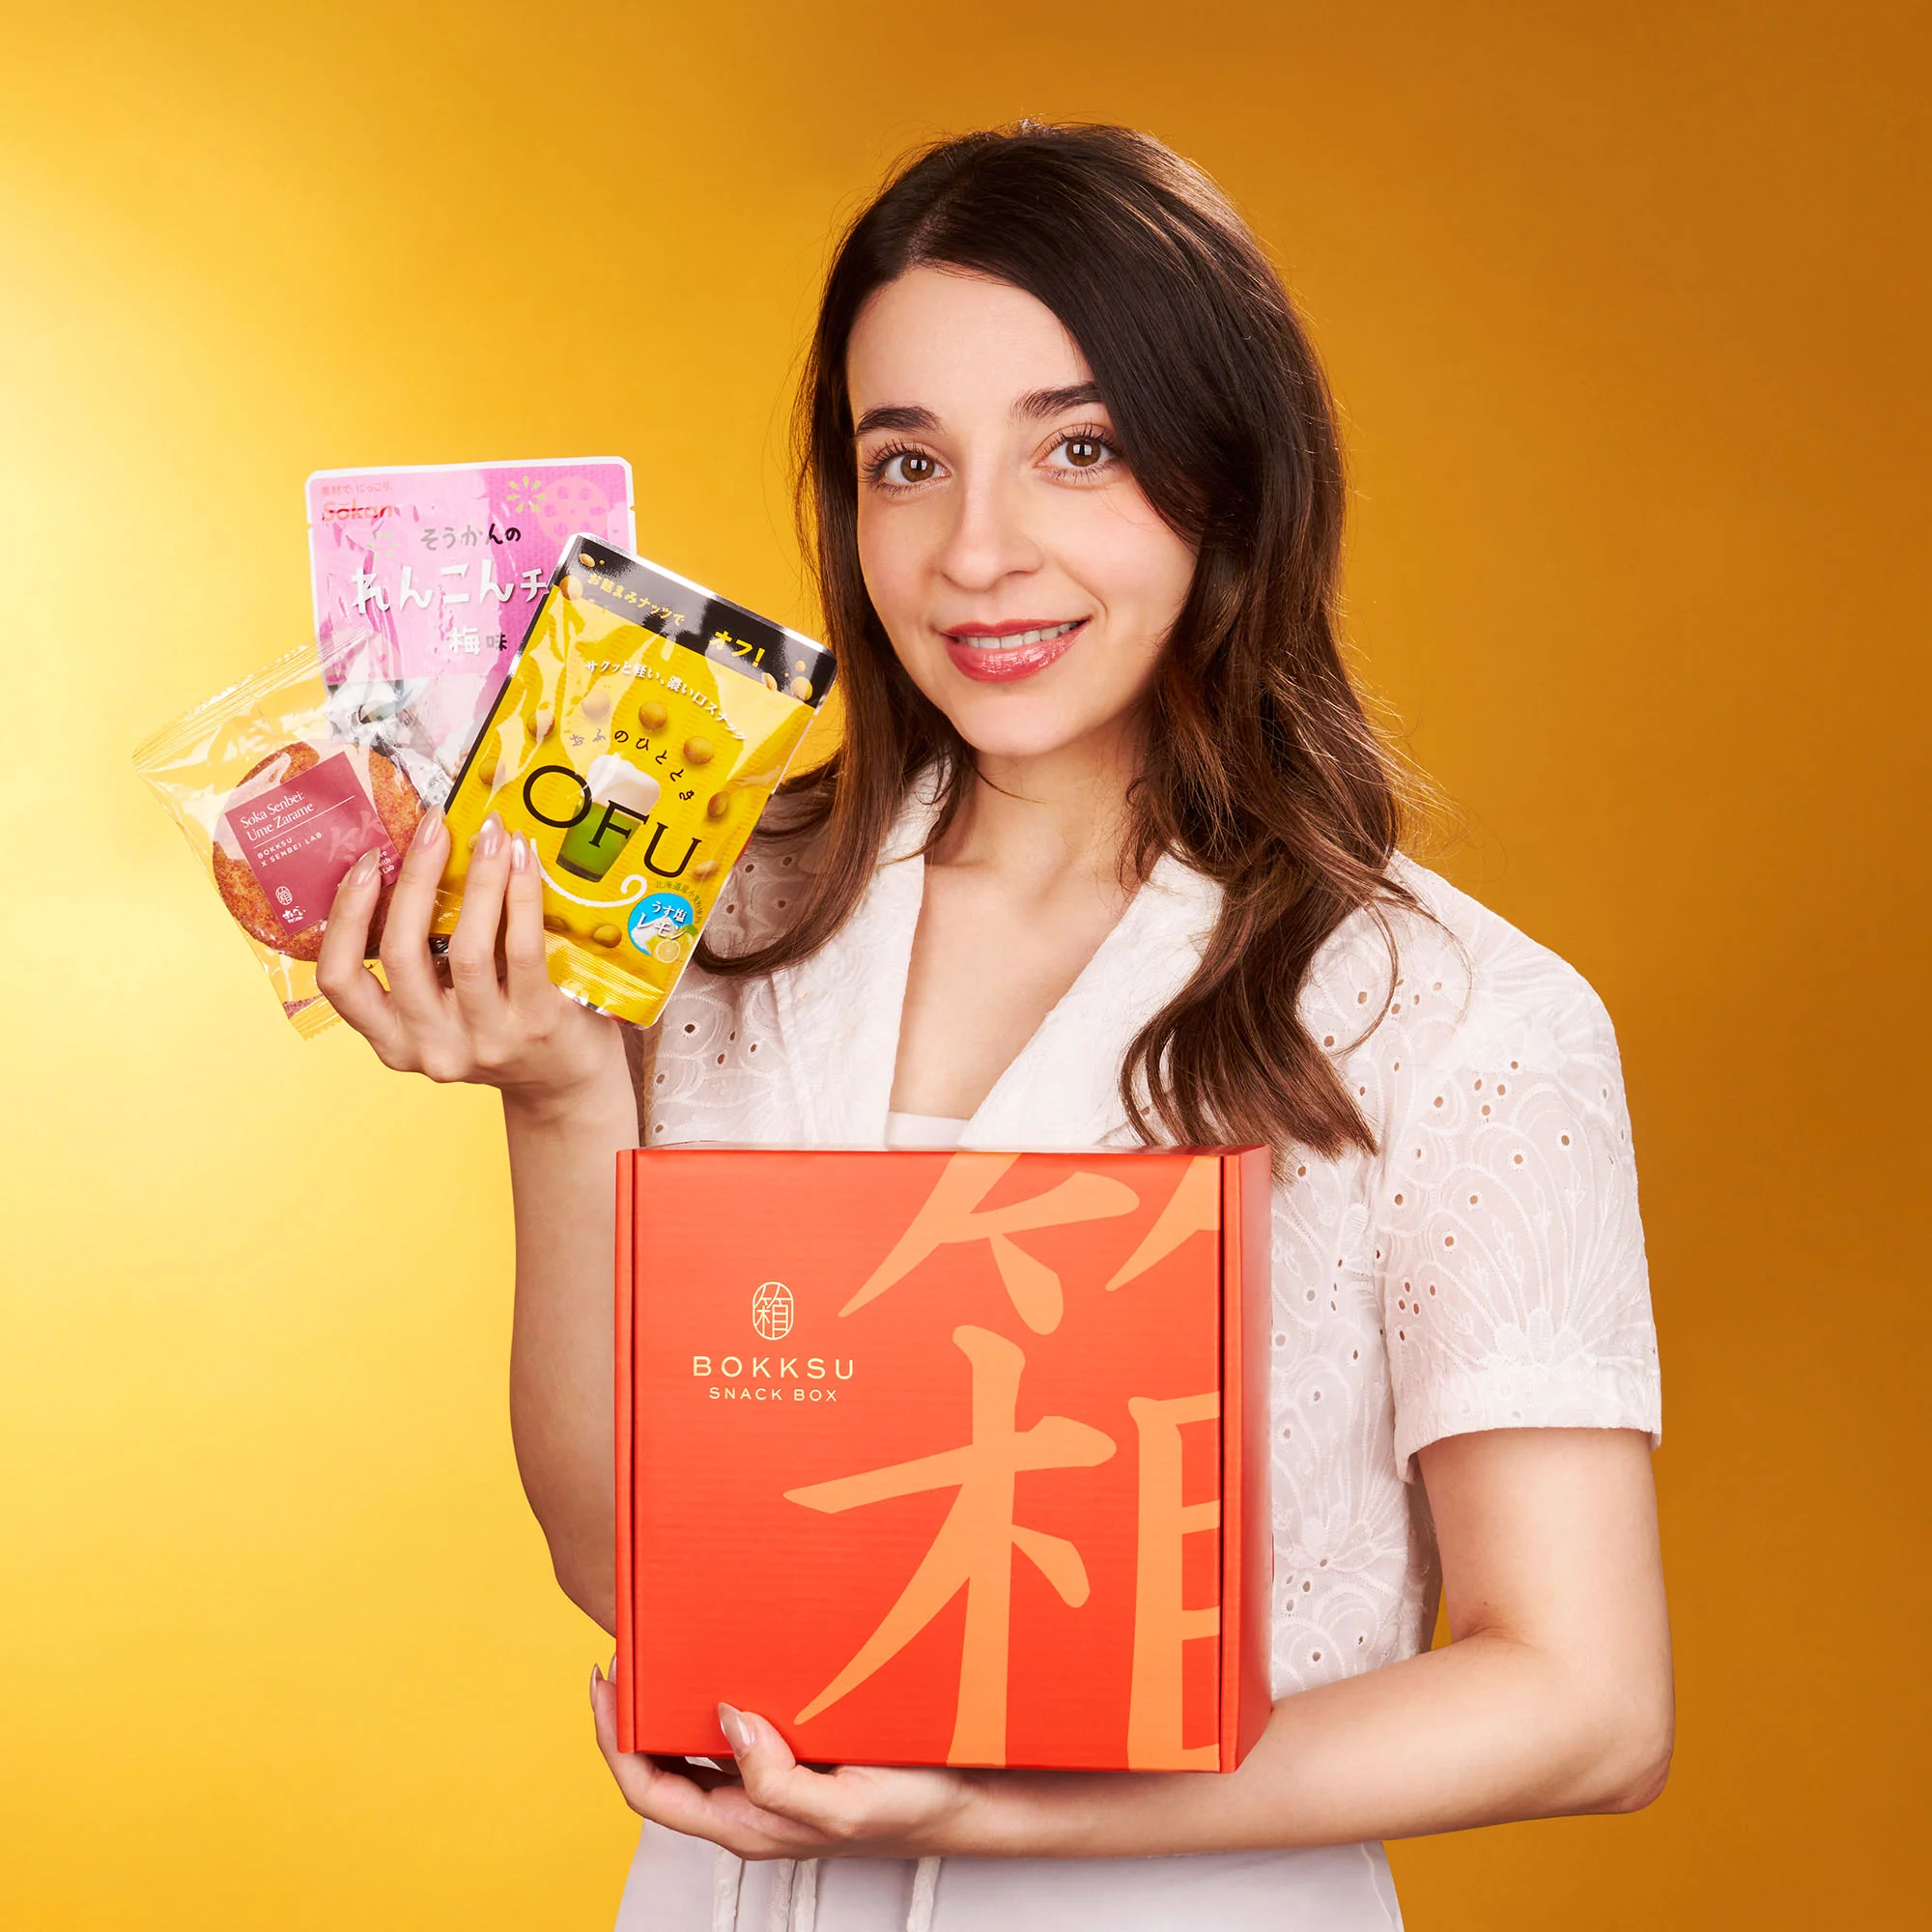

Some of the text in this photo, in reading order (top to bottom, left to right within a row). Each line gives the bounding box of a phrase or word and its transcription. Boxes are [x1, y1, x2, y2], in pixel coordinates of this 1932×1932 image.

[420, 523, 522, 551] そうかんの
[352, 558, 548, 614] れんこんチ
[240, 790, 305, 829] Soka Senbei:
[246, 803, 314, 841] Ume Zarame
[523, 764, 702, 878] OFU
[257, 837, 293, 859] BOKKSU
[270, 842, 302, 863] SENBEI
[304, 832, 323, 844] LAB
[651, 900, 688, 923] うす塩
[638, 912, 687, 940] レモン
[693, 1355, 854, 1379] BOKKSU
[709, 1386, 838, 1402] SNACK BOX
